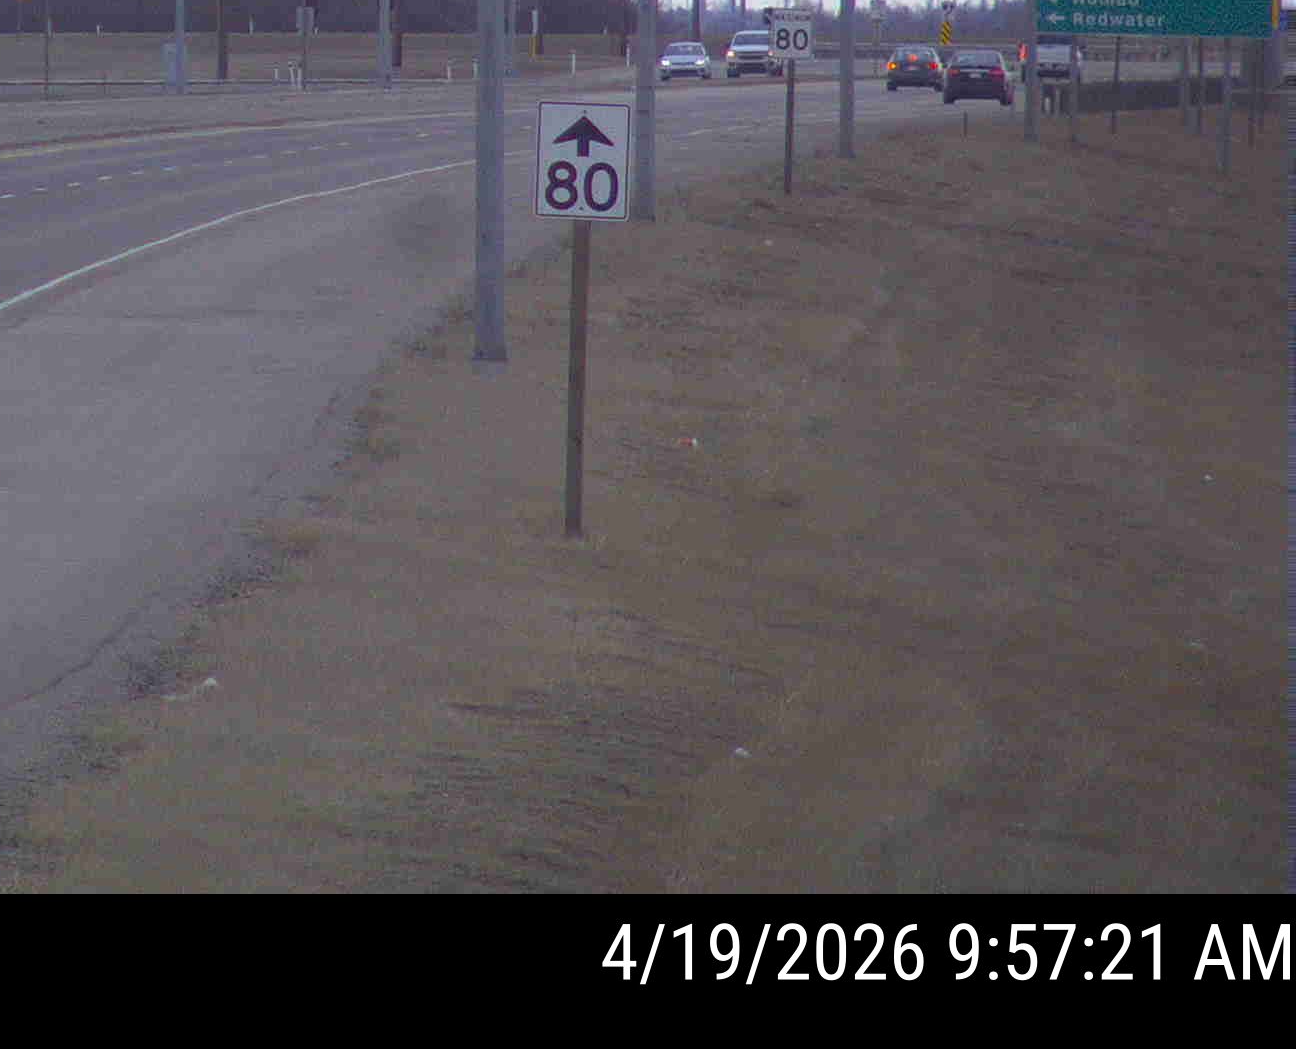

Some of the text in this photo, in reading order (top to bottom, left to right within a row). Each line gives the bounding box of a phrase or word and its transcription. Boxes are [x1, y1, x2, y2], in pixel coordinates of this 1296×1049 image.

[1073, 12, 1166, 27] Redwater
[775, 28, 809, 50] 80
[545, 160, 619, 212] 80
